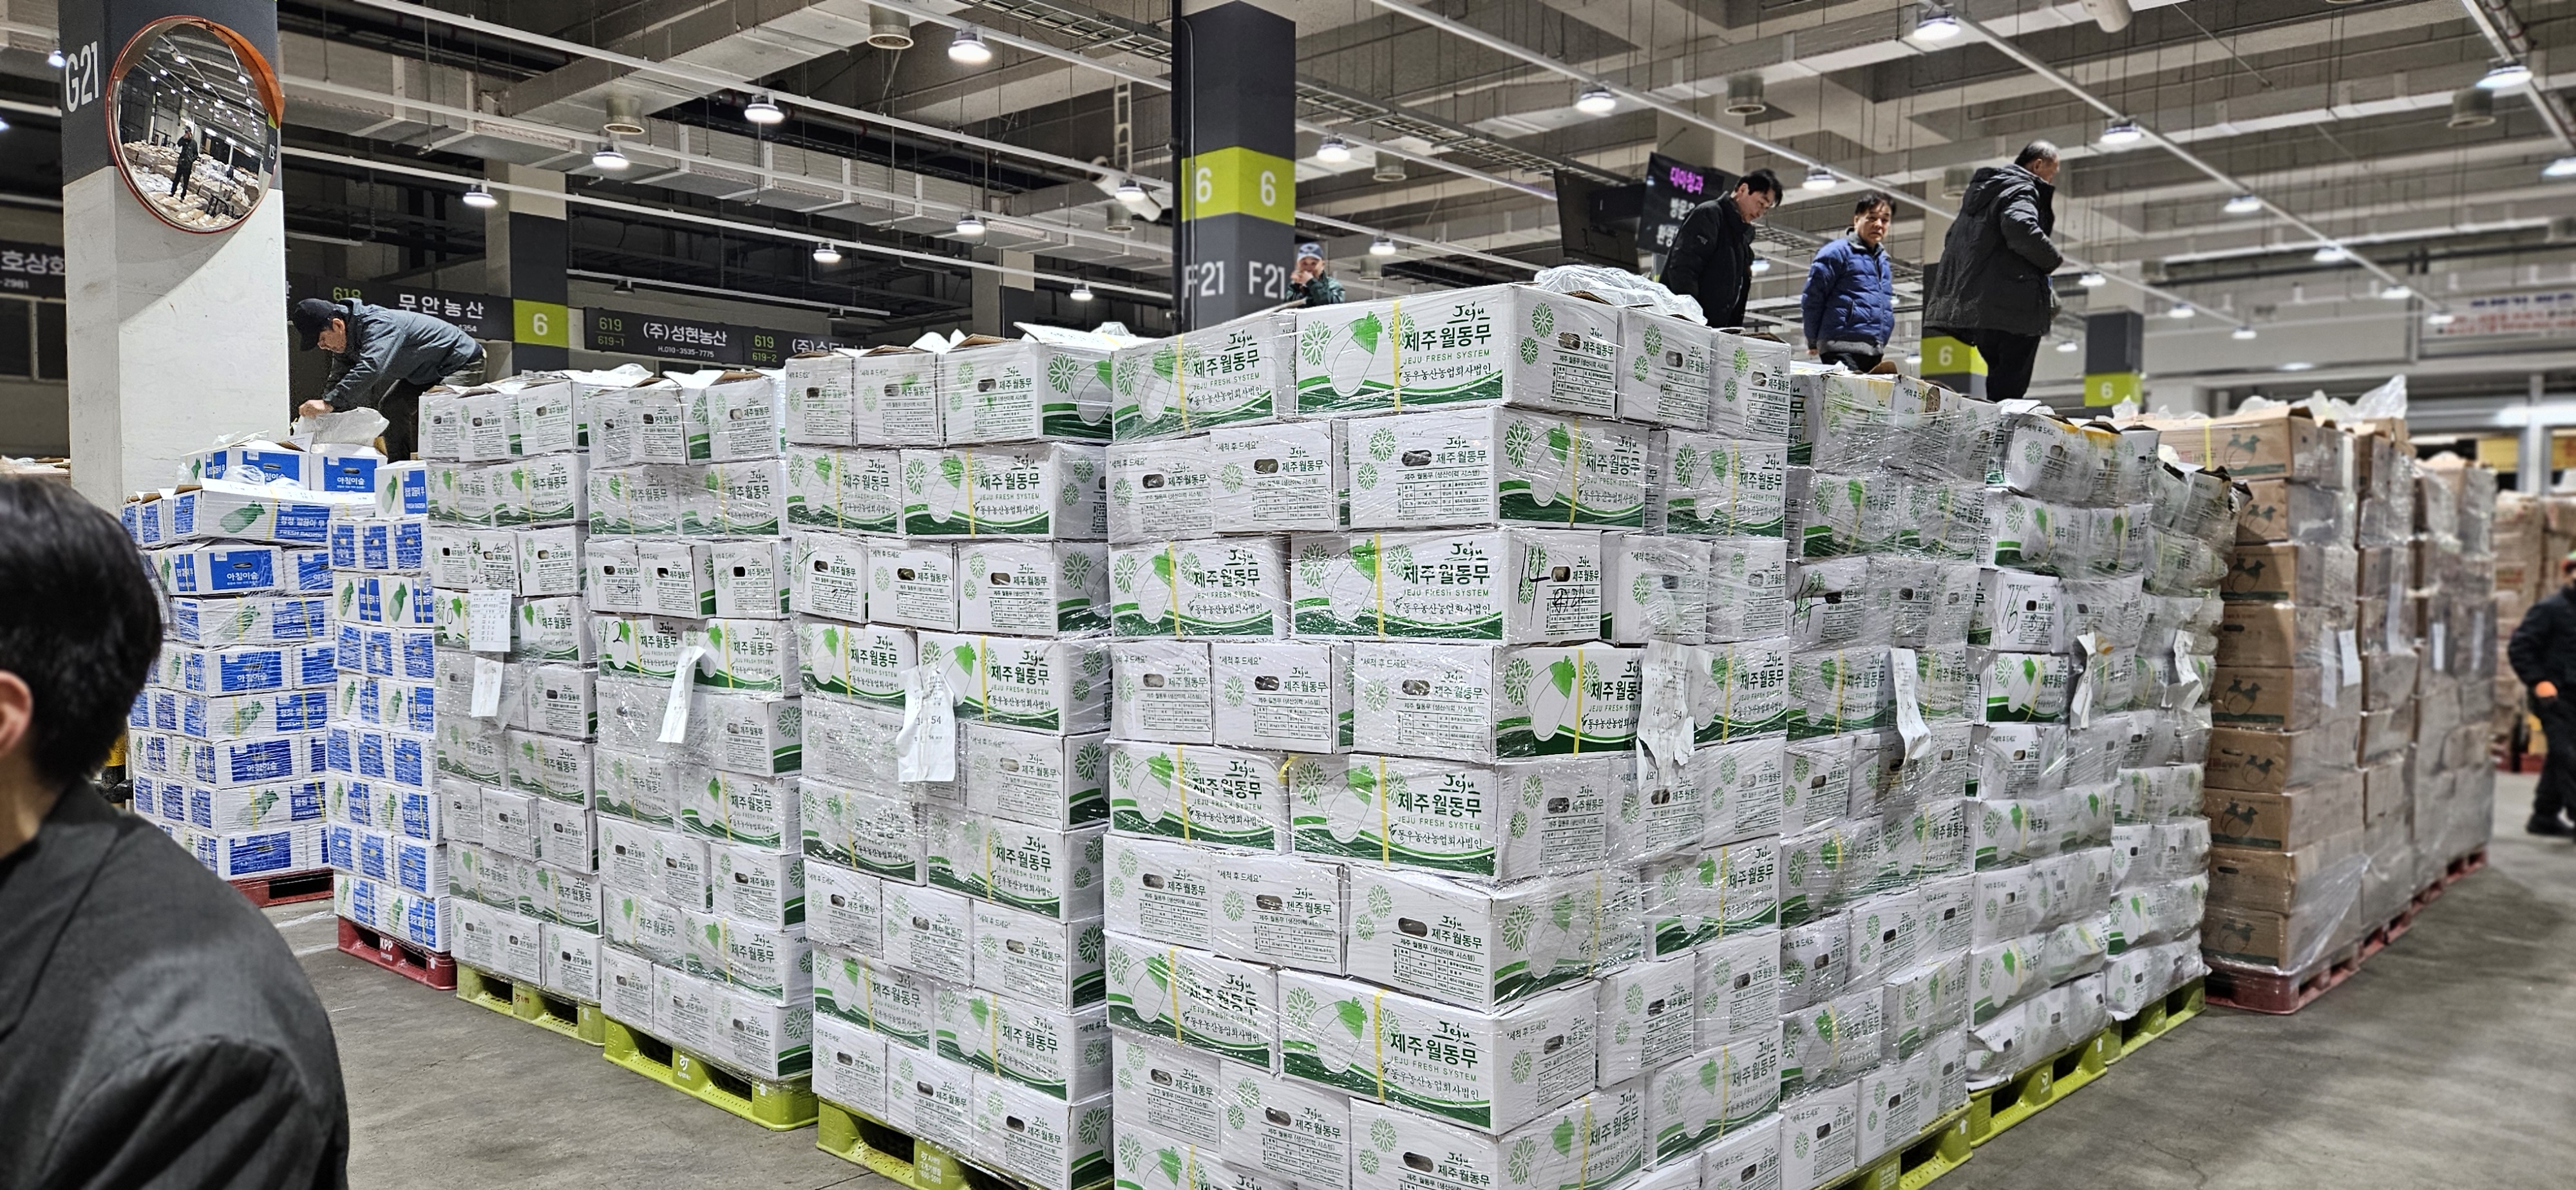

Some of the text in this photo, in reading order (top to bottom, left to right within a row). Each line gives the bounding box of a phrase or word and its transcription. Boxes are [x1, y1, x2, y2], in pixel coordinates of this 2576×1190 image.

[64, 41, 99, 113] G21
[1196, 167, 1212, 203] 6
[1260, 171, 1276, 206] 6
[1184, 261, 1225, 298] F21
[1248, 261, 1285, 299] F21
[333, 286, 361, 301] 618
[398, 293, 484, 320] 무안농산
[533, 313, 548, 336] 6
[599, 317, 621, 332] 619
[598, 335, 625, 347] 619-1
[643, 322, 727, 347] (주)성현농산
[754, 334, 774, 348] 619
[657, 346, 715, 358] H.010-3535-7775
[752, 352, 777, 363] 619-2
[1939, 345, 1952, 366] 6
[2101, 382, 2112, 399] 6
[1215, 441, 1259, 452] "세척 후 드세요"
[337, 477, 365, 485] 아침이슬
[1219, 656, 1262, 666] "세척 후 드세요"
[931, 715, 941, 724] 54
[1653, 706, 1682, 719] 14 54
[1217, 870, 1233, 880] "세척
[1241, 873, 1262, 883] 드세요"
[1413, 941, 1428, 950] 월동무
[1430, 945, 1454, 957] (생산이력
[1456, 952, 1475, 962] 시스템)
